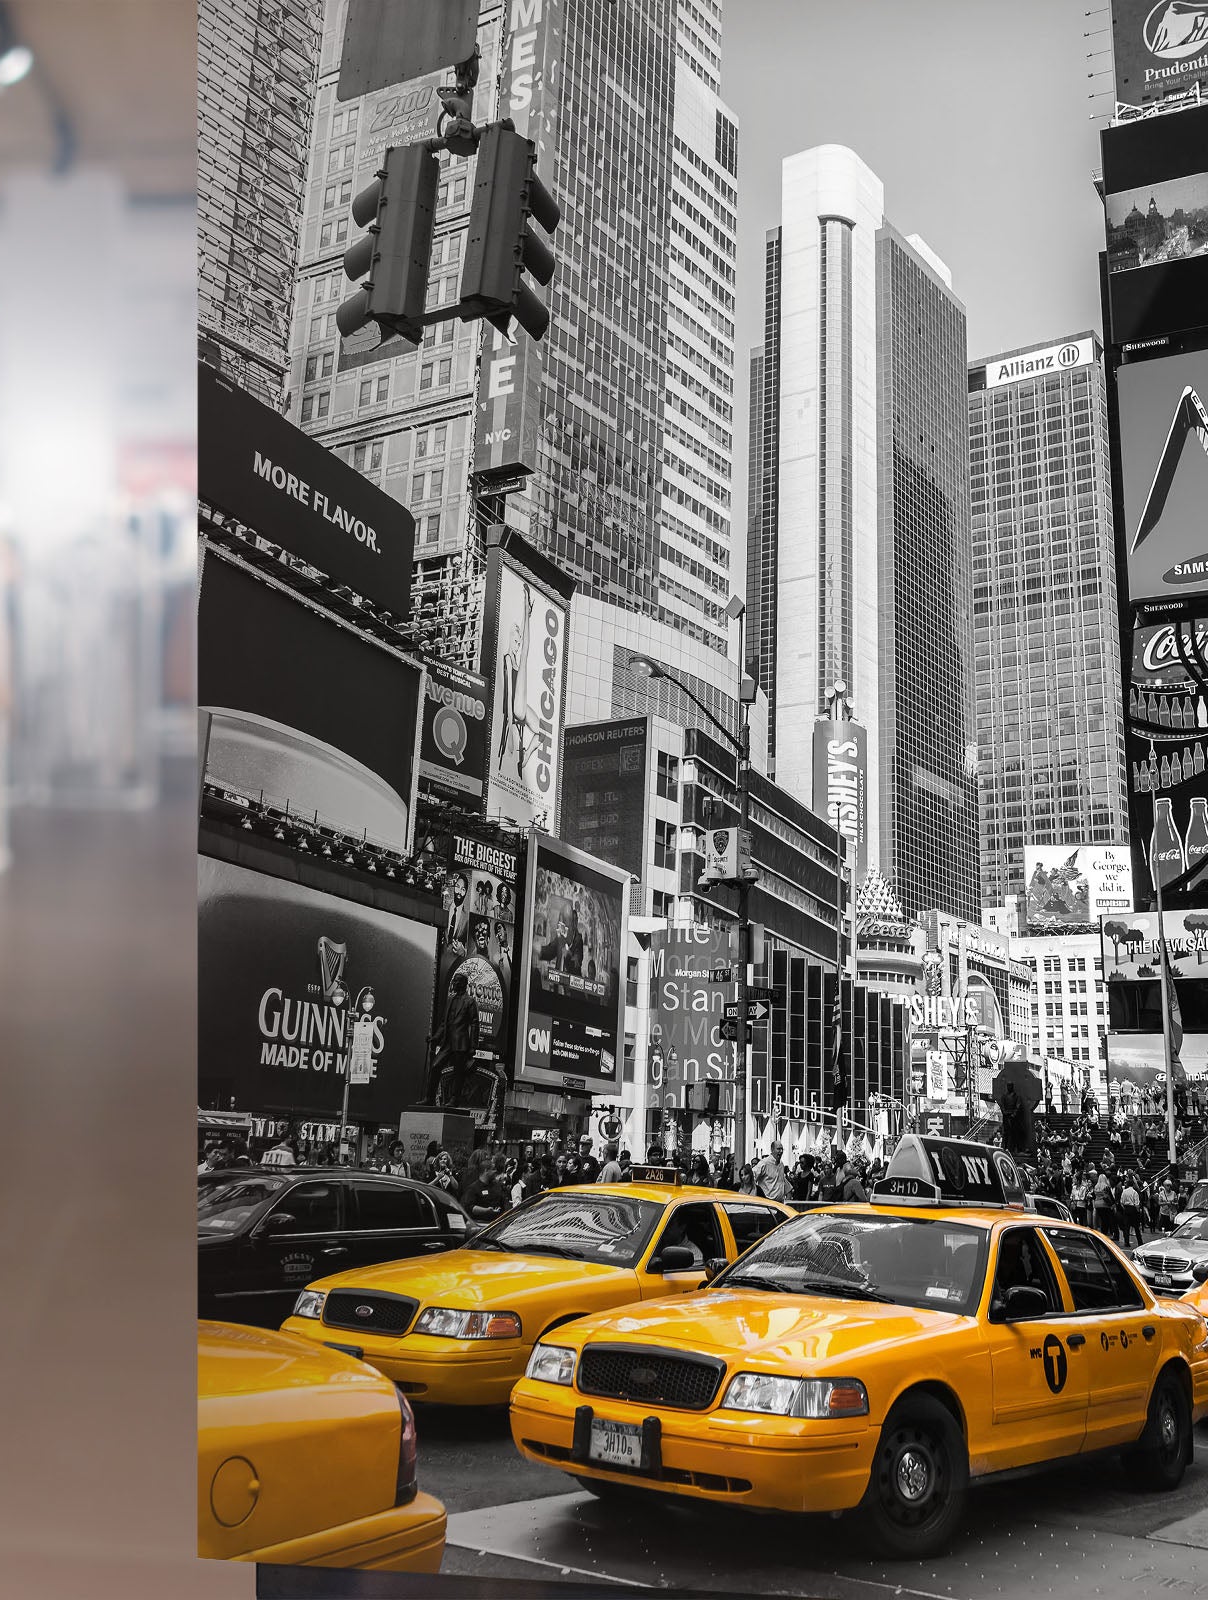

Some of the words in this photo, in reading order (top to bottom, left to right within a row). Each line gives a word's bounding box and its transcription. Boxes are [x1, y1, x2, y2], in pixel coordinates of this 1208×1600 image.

[998, 354, 1054, 381] Allianz
[485, 428, 512, 445] NYC
[253, 450, 310, 506] MORE
[313, 490, 381, 555] FLAVOR.
[425, 673, 486, 721] Avenue
[536, 608, 559, 793] CHICAGO
[433, 705, 467, 766] Q
[566, 732, 605, 747] THOMSON
[607, 726, 645, 741] REUTERS
[454, 853, 463, 863] BOX
[464, 856, 480, 868] OFFICE
[488, 863, 494, 873] OF
[495, 866, 503, 876] THE
[477, 843, 517, 872] BIGGEST
[1105, 851, 1115, 862] By
[1092, 861, 1130, 873] George,
[1099, 882, 1114, 892] did
[1116, 882, 1125, 892] it.
[1125, 940, 1151, 955] THE
[1153, 938, 1186, 953] NEW
[675, 968, 702, 979] Morgan
[715, 970, 724, 982] 46
[258, 987, 385, 1054] GUINNS
[728, 1007, 738, 1017] ON
[748, 1005, 758, 1016] AY
[528, 1027, 551, 1055] CNN
[553, 1038, 565, 1047] Follow
[564, 1041, 573, 1049] these
[573, 1044, 585, 1052] stories
[260, 1042, 310, 1069] MADE
[312, 1049, 333, 1072] OF
[335, 1053, 378, 1079] ME
[560, 1049, 569, 1058] CNN
[568, 1051, 580, 1060] Mobile
[300, 1121, 337, 1143] SLAM
[264, 1152, 283, 1165] TAXI
[930, 1151, 946, 1181] I
[961, 1155, 992, 1185] NY
[645, 1168, 664, 1181] 2A26
[890, 1181, 919, 1195] 3H10
[1030, 1348, 1042, 1359] NYC
[1047, 1345, 1061, 1386] T
